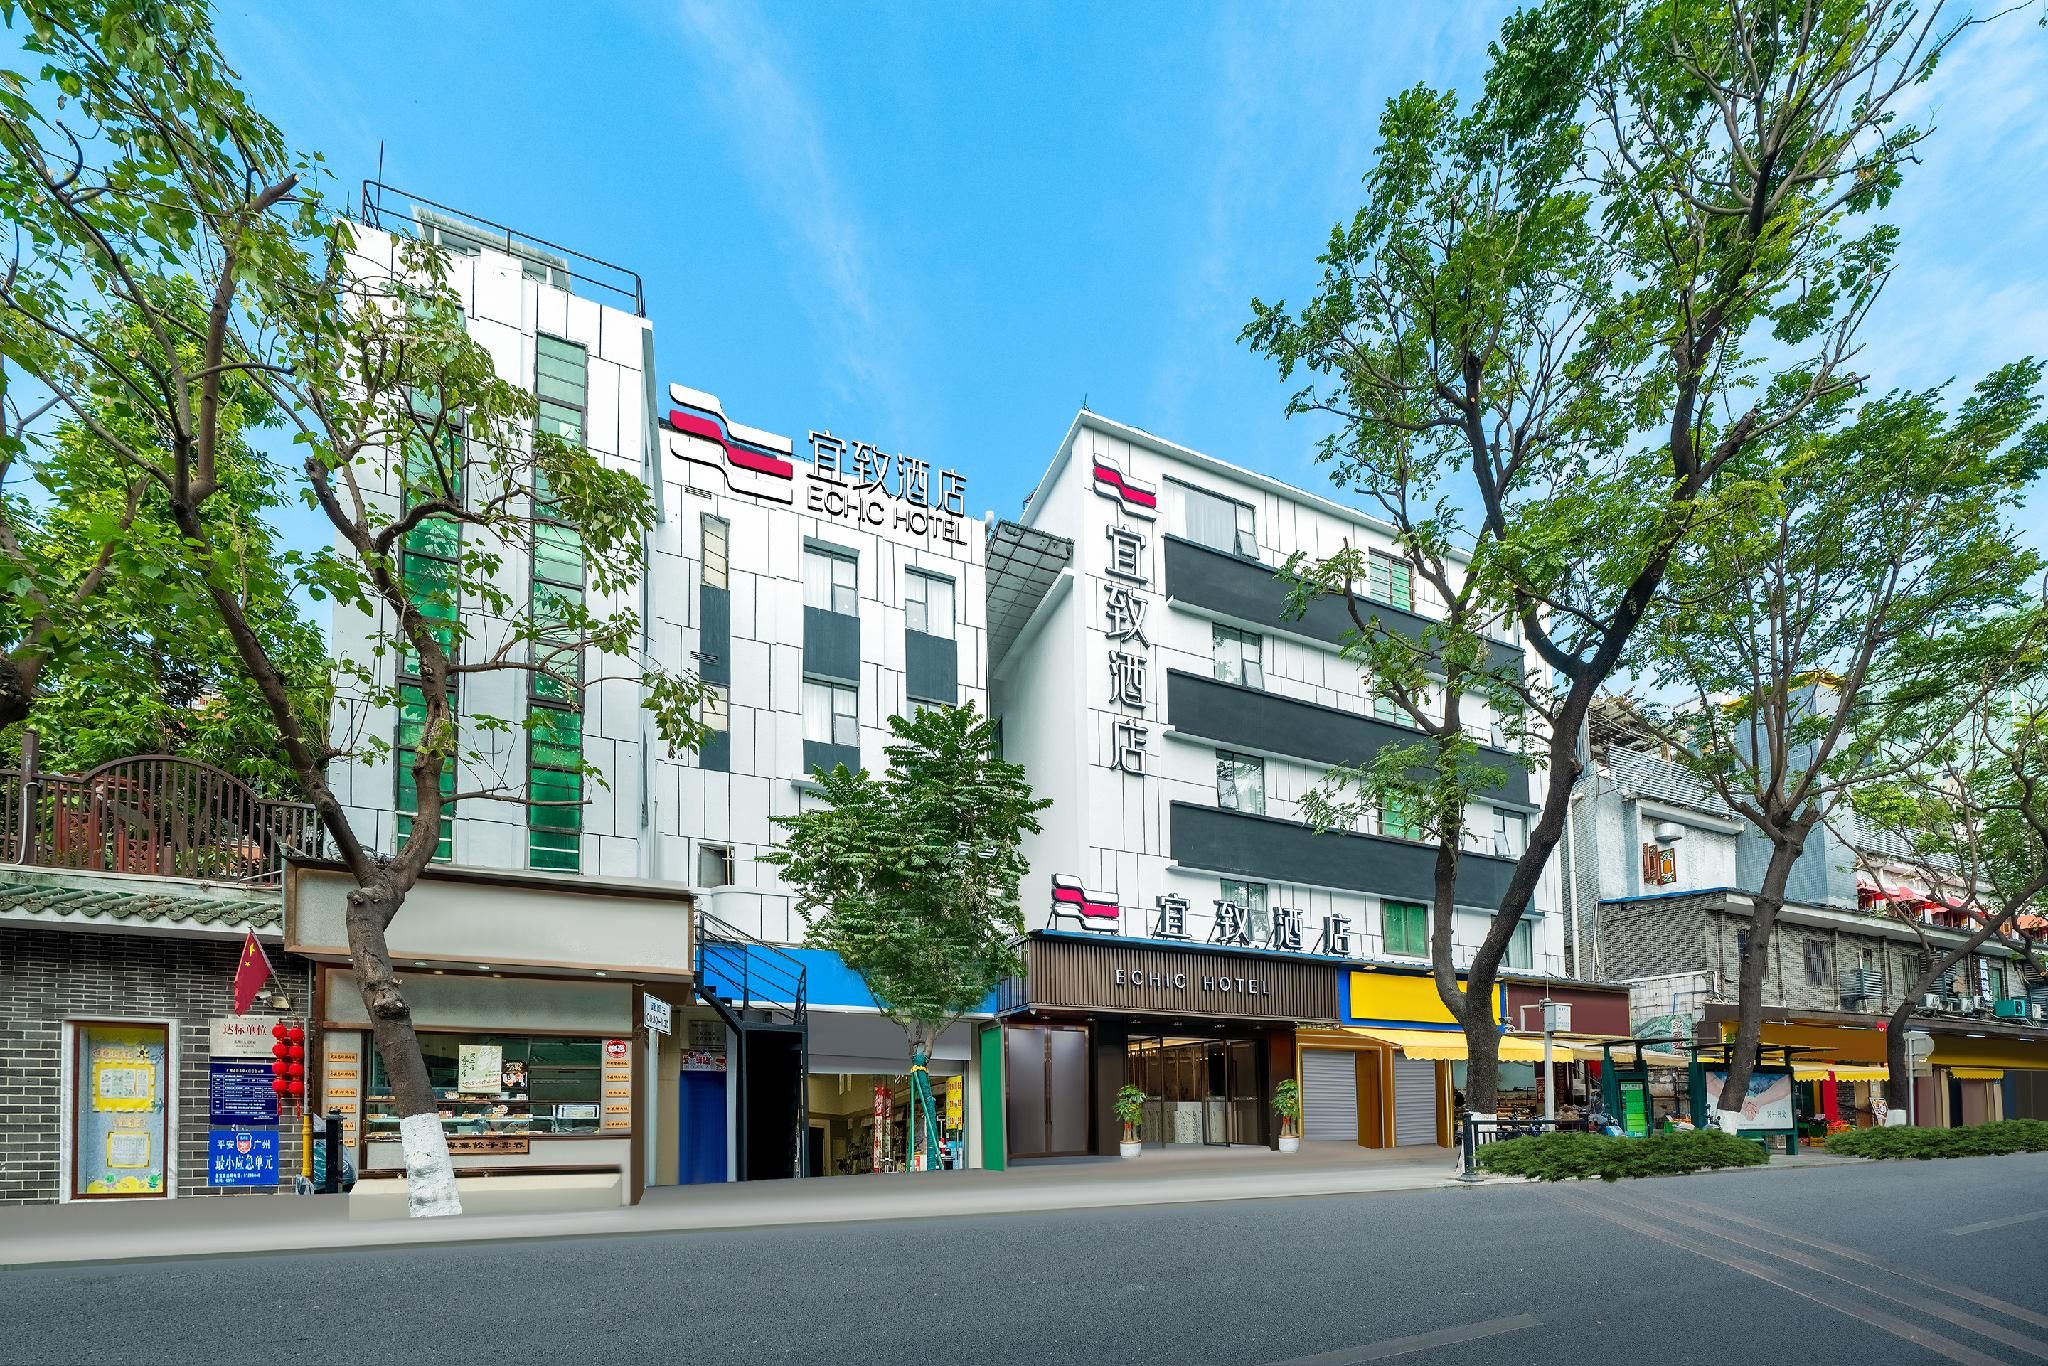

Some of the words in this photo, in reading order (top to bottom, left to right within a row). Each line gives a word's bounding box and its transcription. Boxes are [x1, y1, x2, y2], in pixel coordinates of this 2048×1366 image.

[806, 429, 967, 517] 宜致酒店
[807, 484, 884, 526] ECHIC
[893, 506, 967, 546] HOTEL
[1105, 524, 1149, 776] 宜致酒店
[1155, 893, 1352, 956] 宜致酒店
[1115, 969, 1186, 989] ECHIC
[1203, 976, 1270, 996] HOTEL
[223, 1023, 267, 1036] 达标单位
[215, 1154, 273, 1171] 最小应急单元
[217, 1140, 235, 1150] 平安
[253, 1140, 271, 1150] 广州
